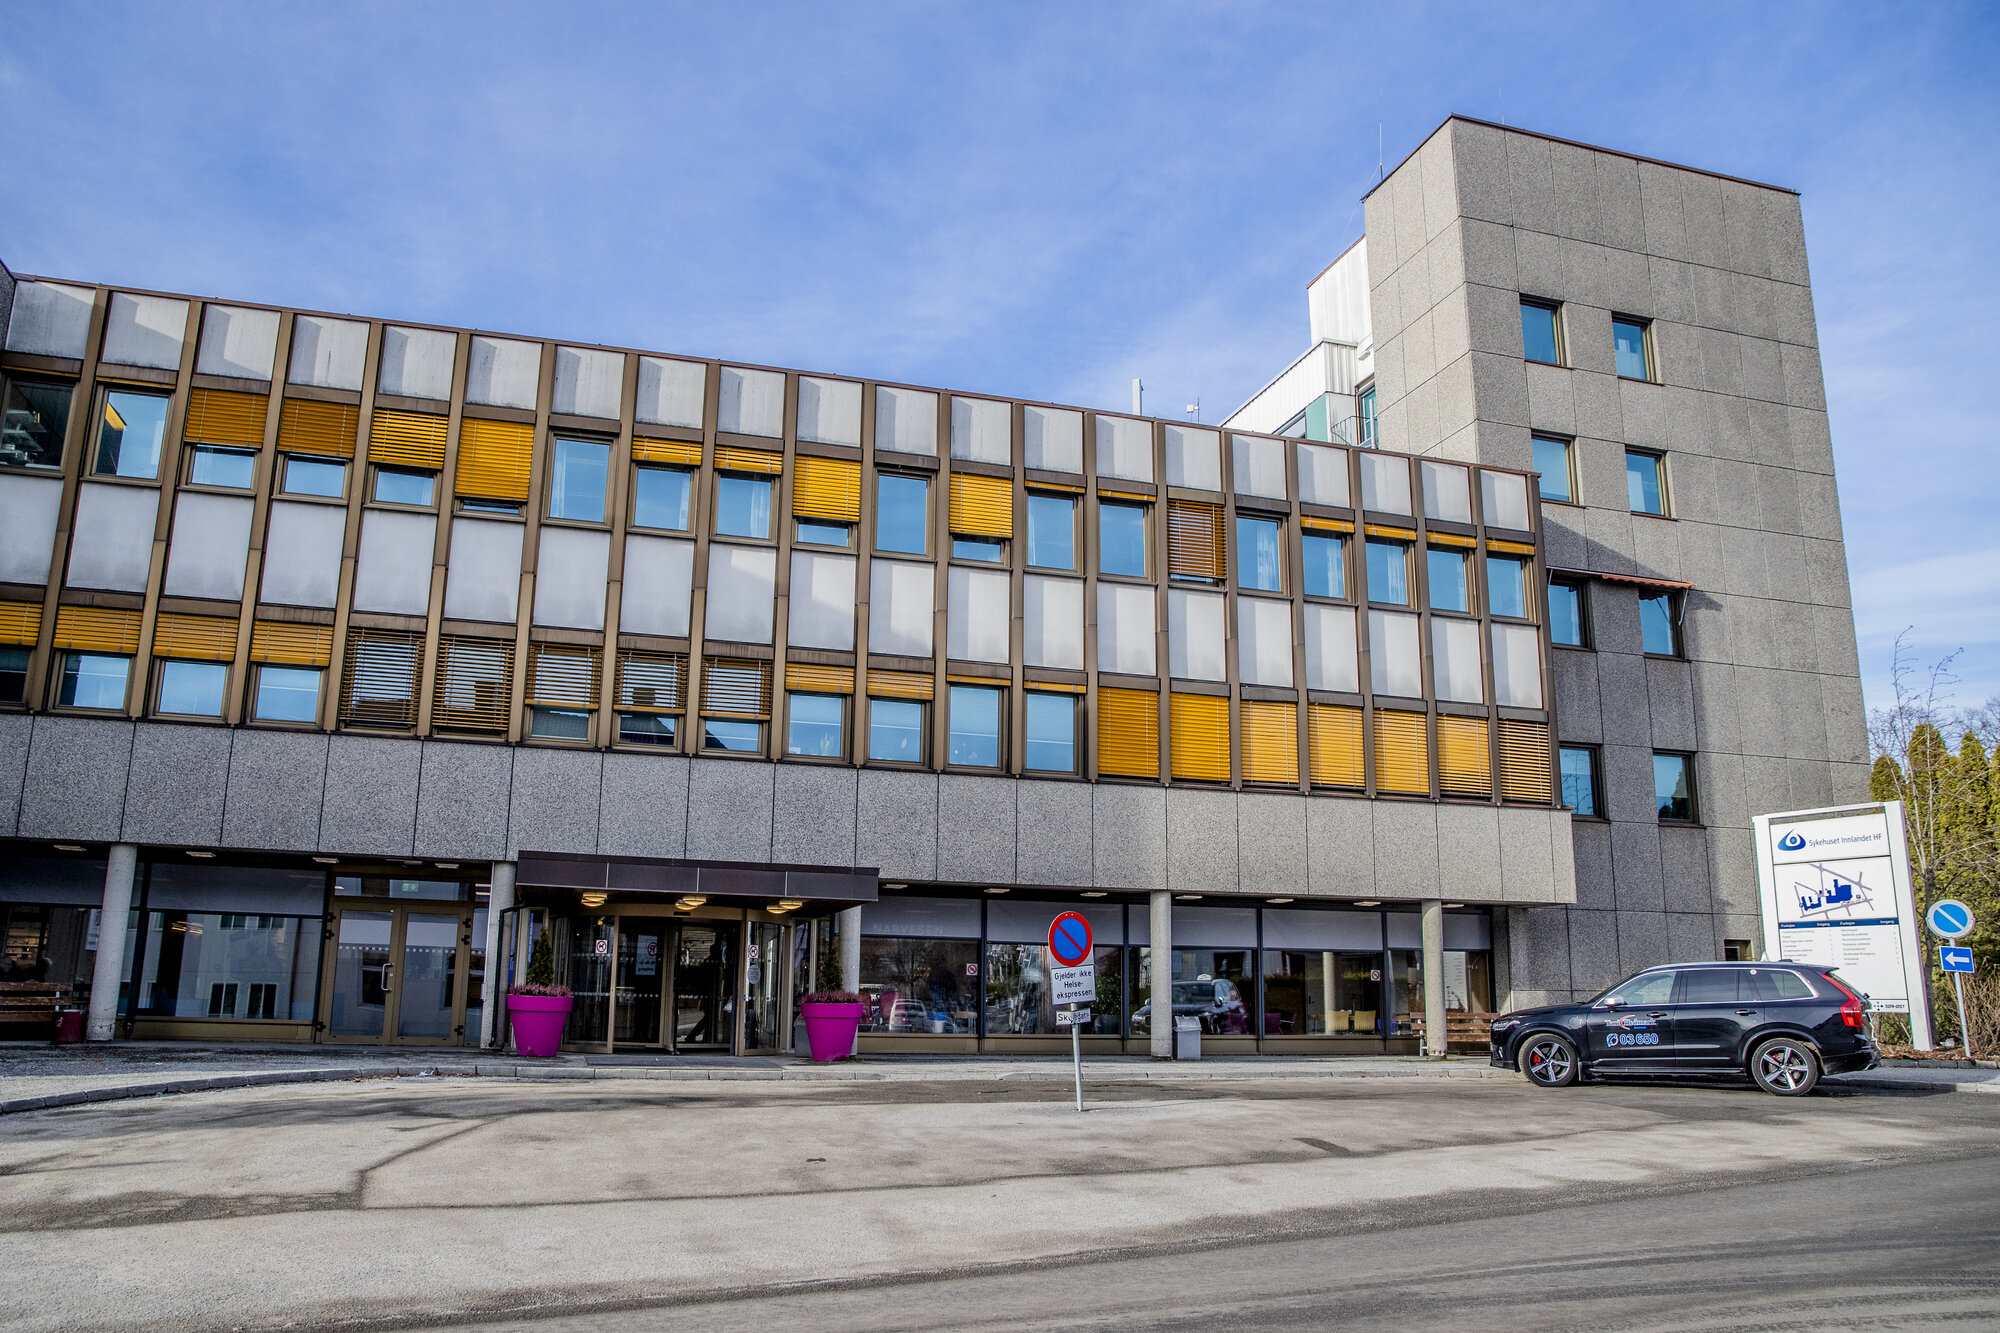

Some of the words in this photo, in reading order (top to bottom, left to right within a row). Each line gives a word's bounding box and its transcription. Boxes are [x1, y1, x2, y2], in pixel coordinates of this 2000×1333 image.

[1809, 837, 1840, 847] Sykehuset
[1842, 834, 1872, 844] Innlandet
[873, 923, 944, 935] NARVESEN
[1054, 971, 1076, 981] Gjelder
[1056, 989, 1092, 999] ekspressen
